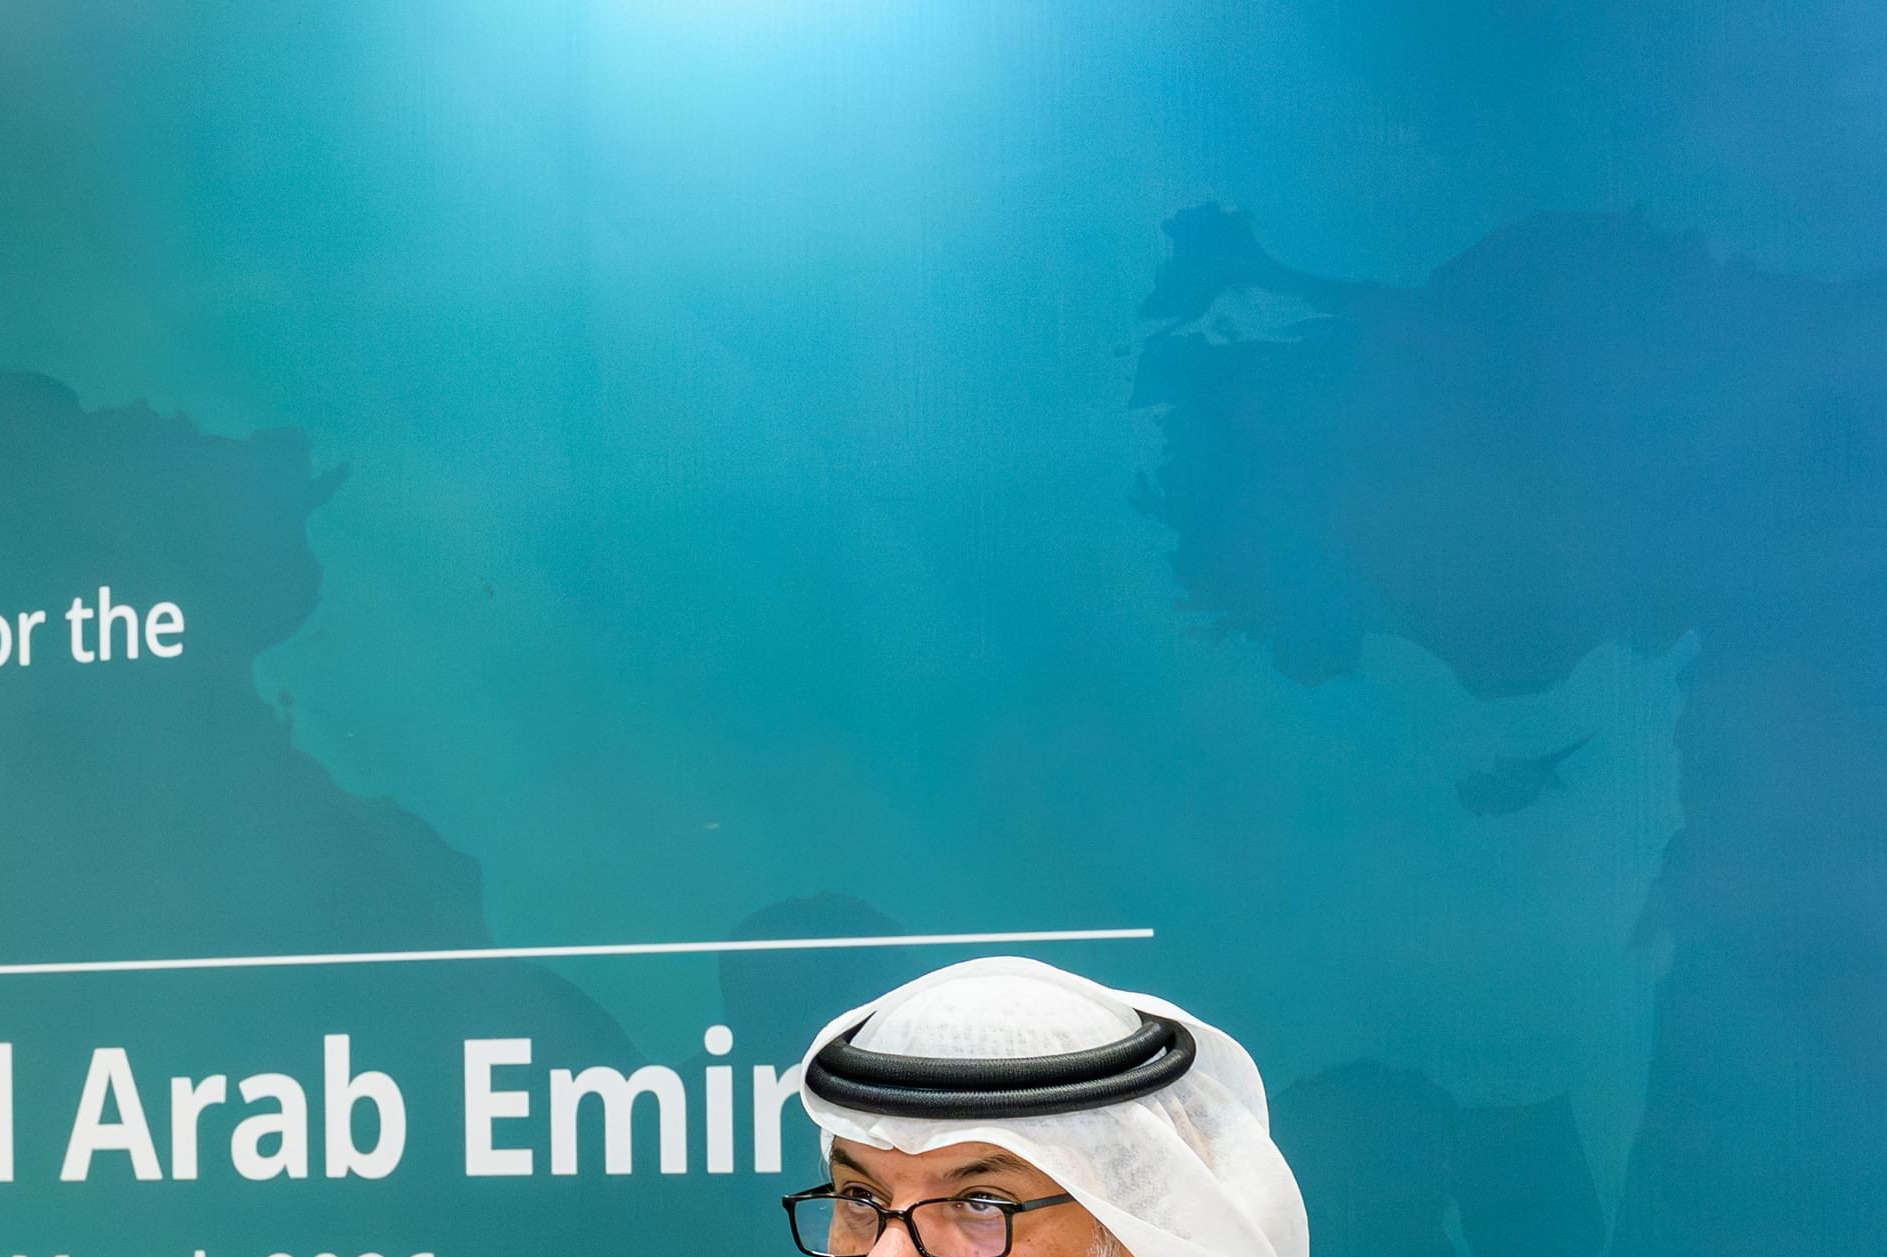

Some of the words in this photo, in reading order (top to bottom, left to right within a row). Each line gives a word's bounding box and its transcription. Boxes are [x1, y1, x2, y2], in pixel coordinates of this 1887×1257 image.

[65, 586, 185, 663] the
[60, 1034, 406, 1181] Arab
[464, 1025, 803, 1176] Emir
